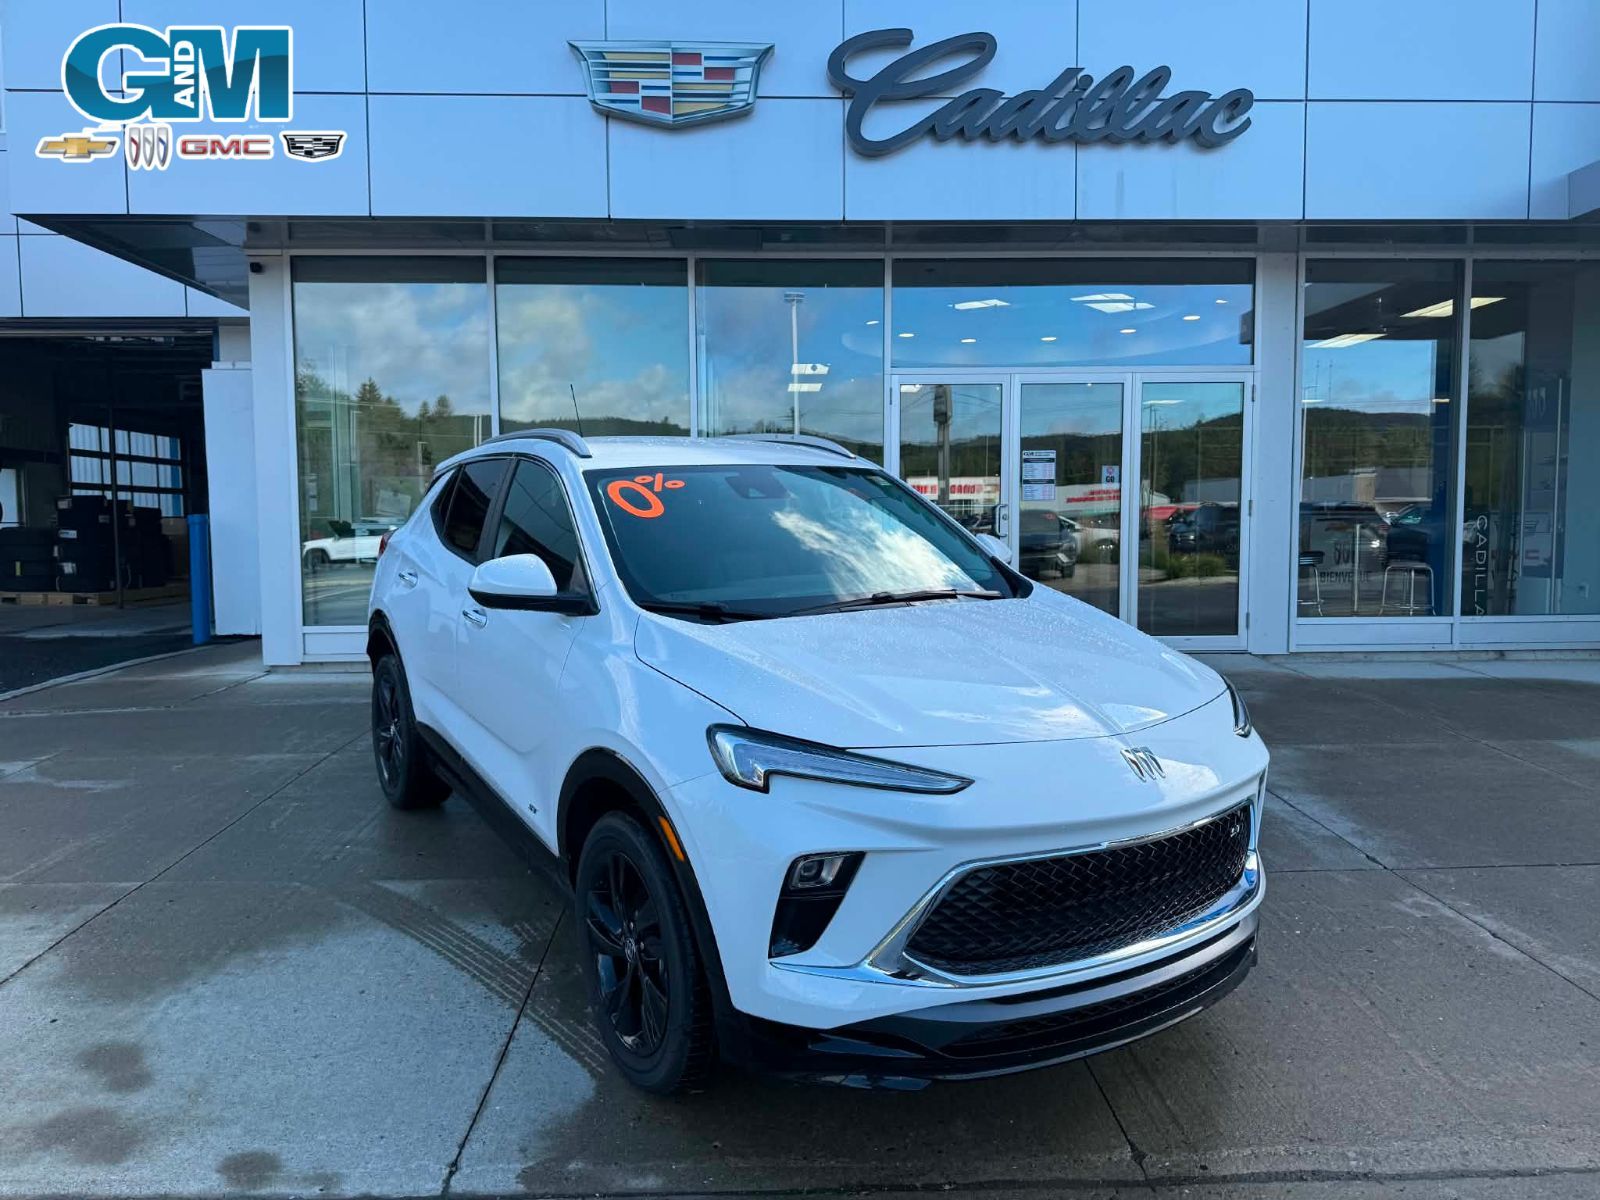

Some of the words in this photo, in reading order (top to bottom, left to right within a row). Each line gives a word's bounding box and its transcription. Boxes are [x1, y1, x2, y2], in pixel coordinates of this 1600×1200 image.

[827, 28, 1254, 157] Cadillac
[607, 472, 685, 518] 0%
[1474, 514, 1488, 616] CADILLA
